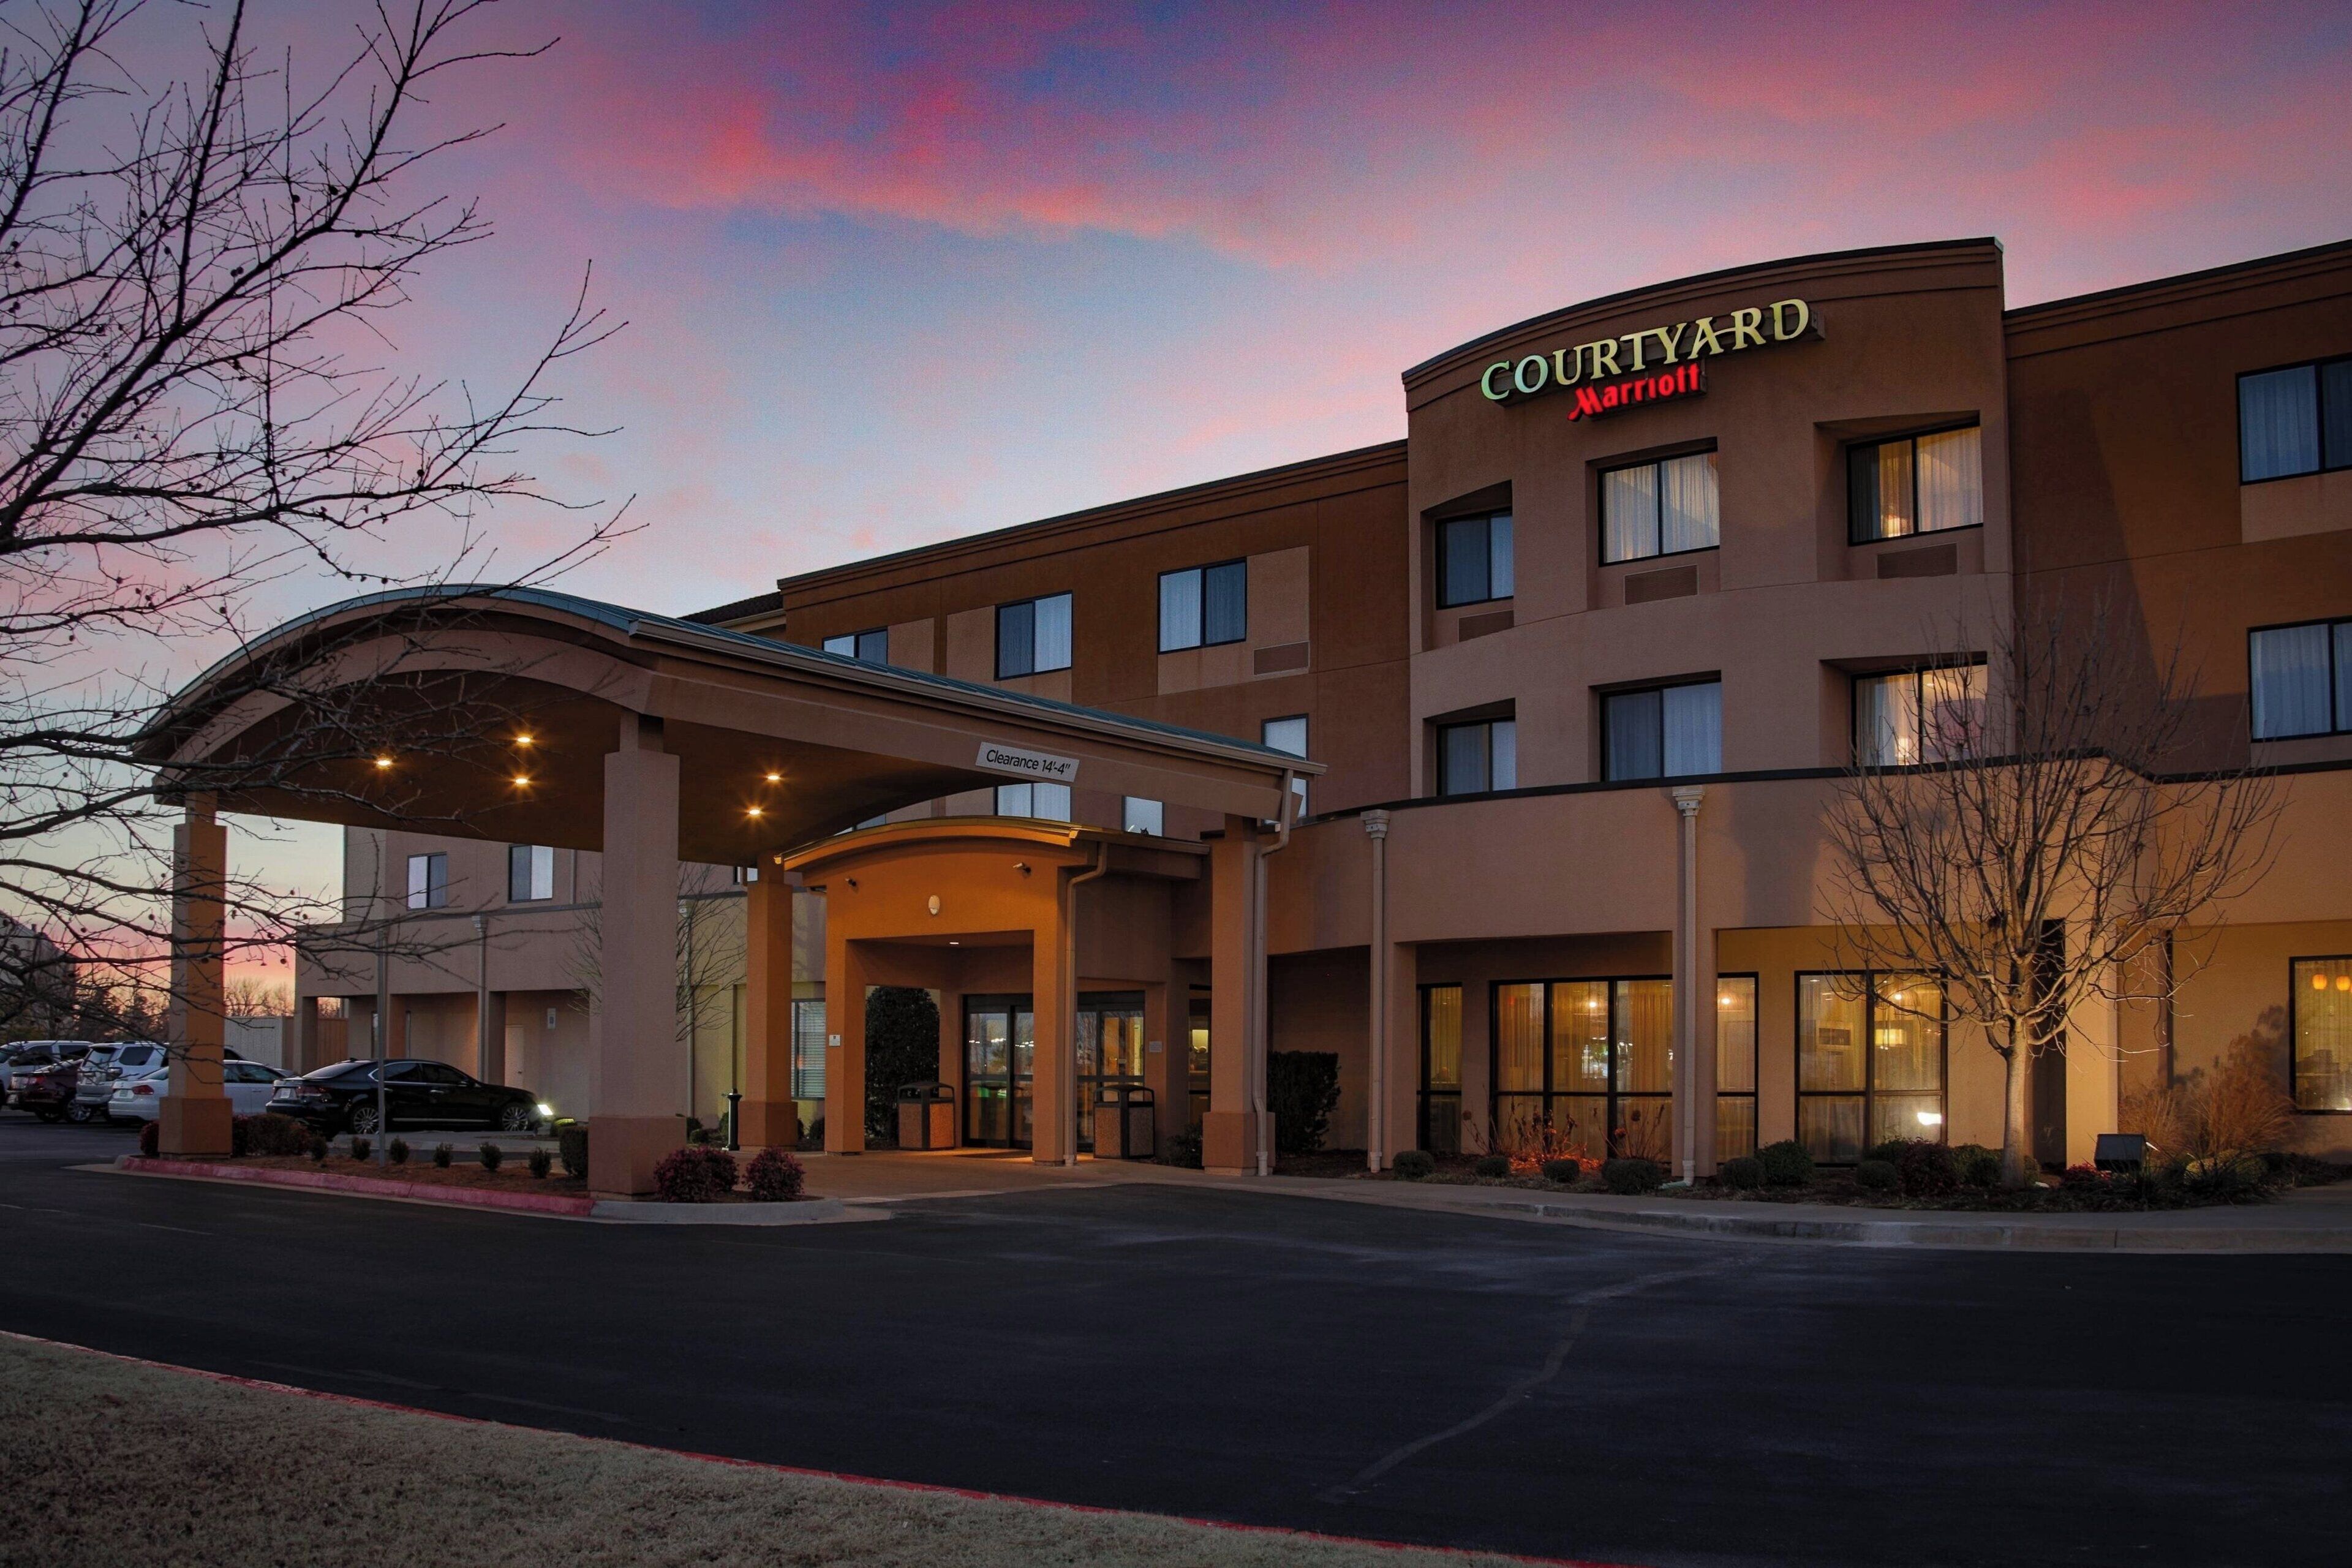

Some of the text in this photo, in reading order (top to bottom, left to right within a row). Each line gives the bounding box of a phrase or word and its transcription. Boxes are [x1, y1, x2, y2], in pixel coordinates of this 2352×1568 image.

[1481, 299, 1809, 400] COURTYARD
[1567, 363, 1702, 421] Marriott
[986, 749, 1039, 770] Clearance
